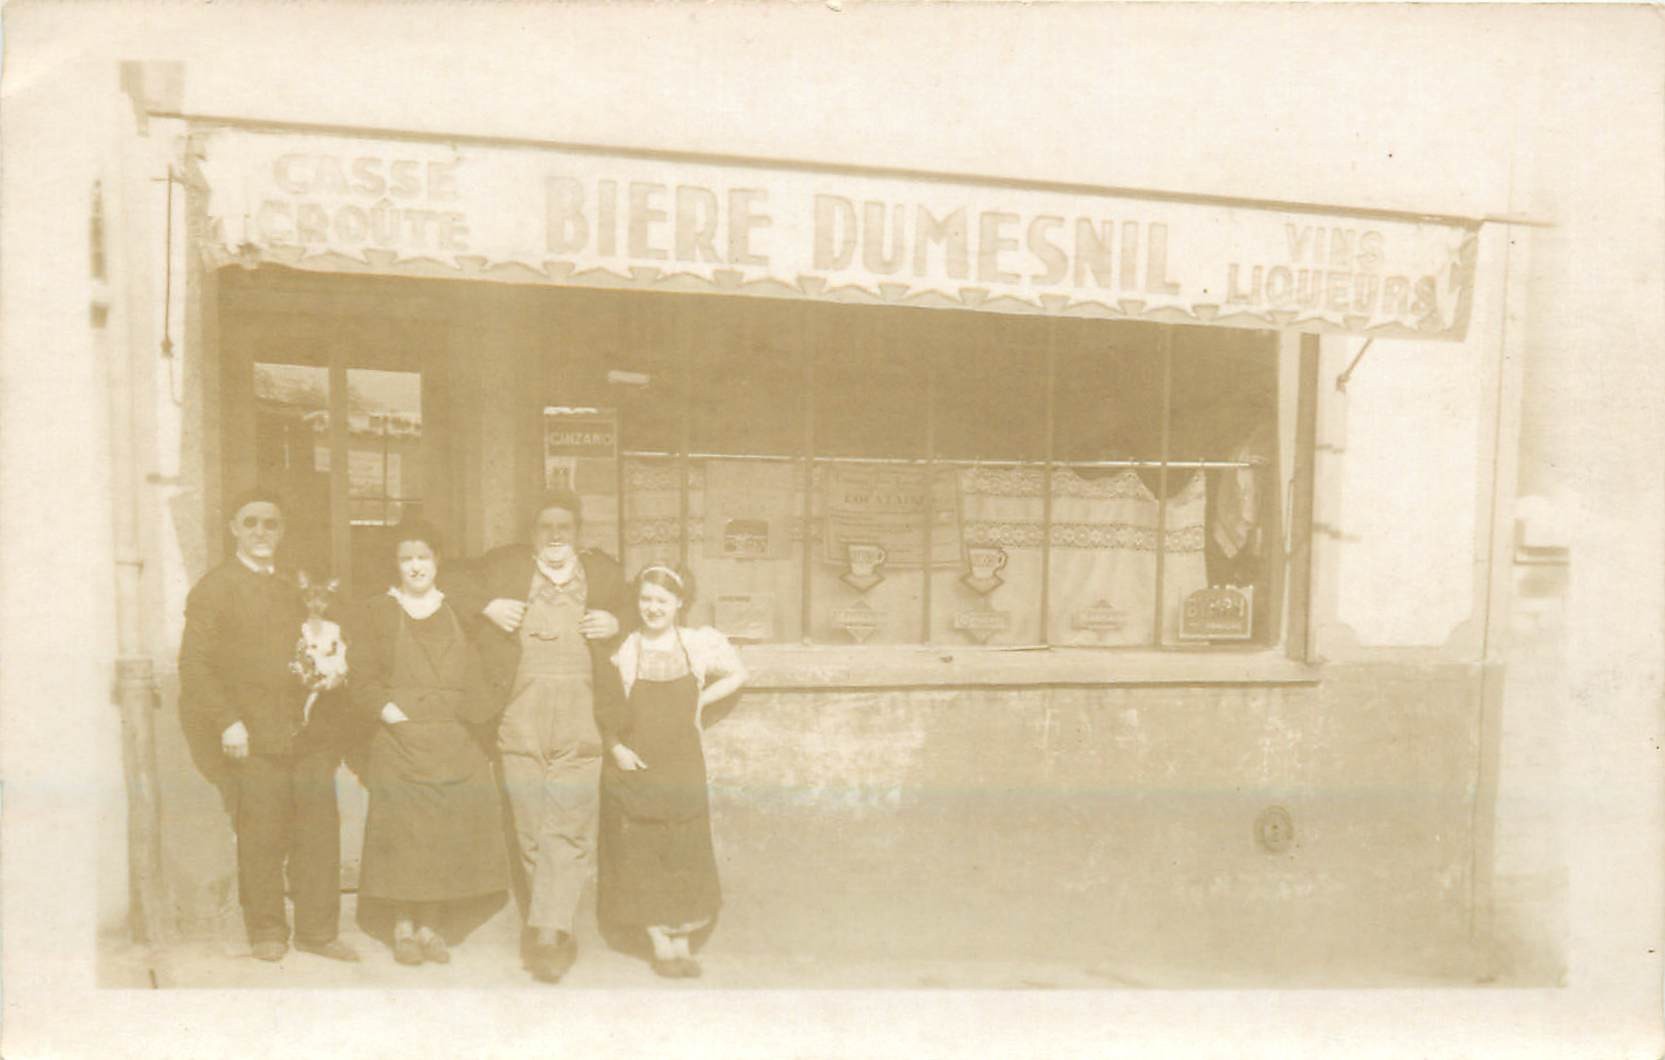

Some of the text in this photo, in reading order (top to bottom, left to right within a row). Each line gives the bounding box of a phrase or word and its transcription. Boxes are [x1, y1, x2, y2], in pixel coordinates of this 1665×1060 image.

[273, 152, 460, 203] CASSE
[256, 196, 470, 251] CROÛTE
[545, 176, 1181, 296] BIERE DUMESNIL
[1285, 222, 1384, 267] VINS
[1226, 263, 1438, 316] LIQUEURS
[550, 431, 614, 447] CINZANO
